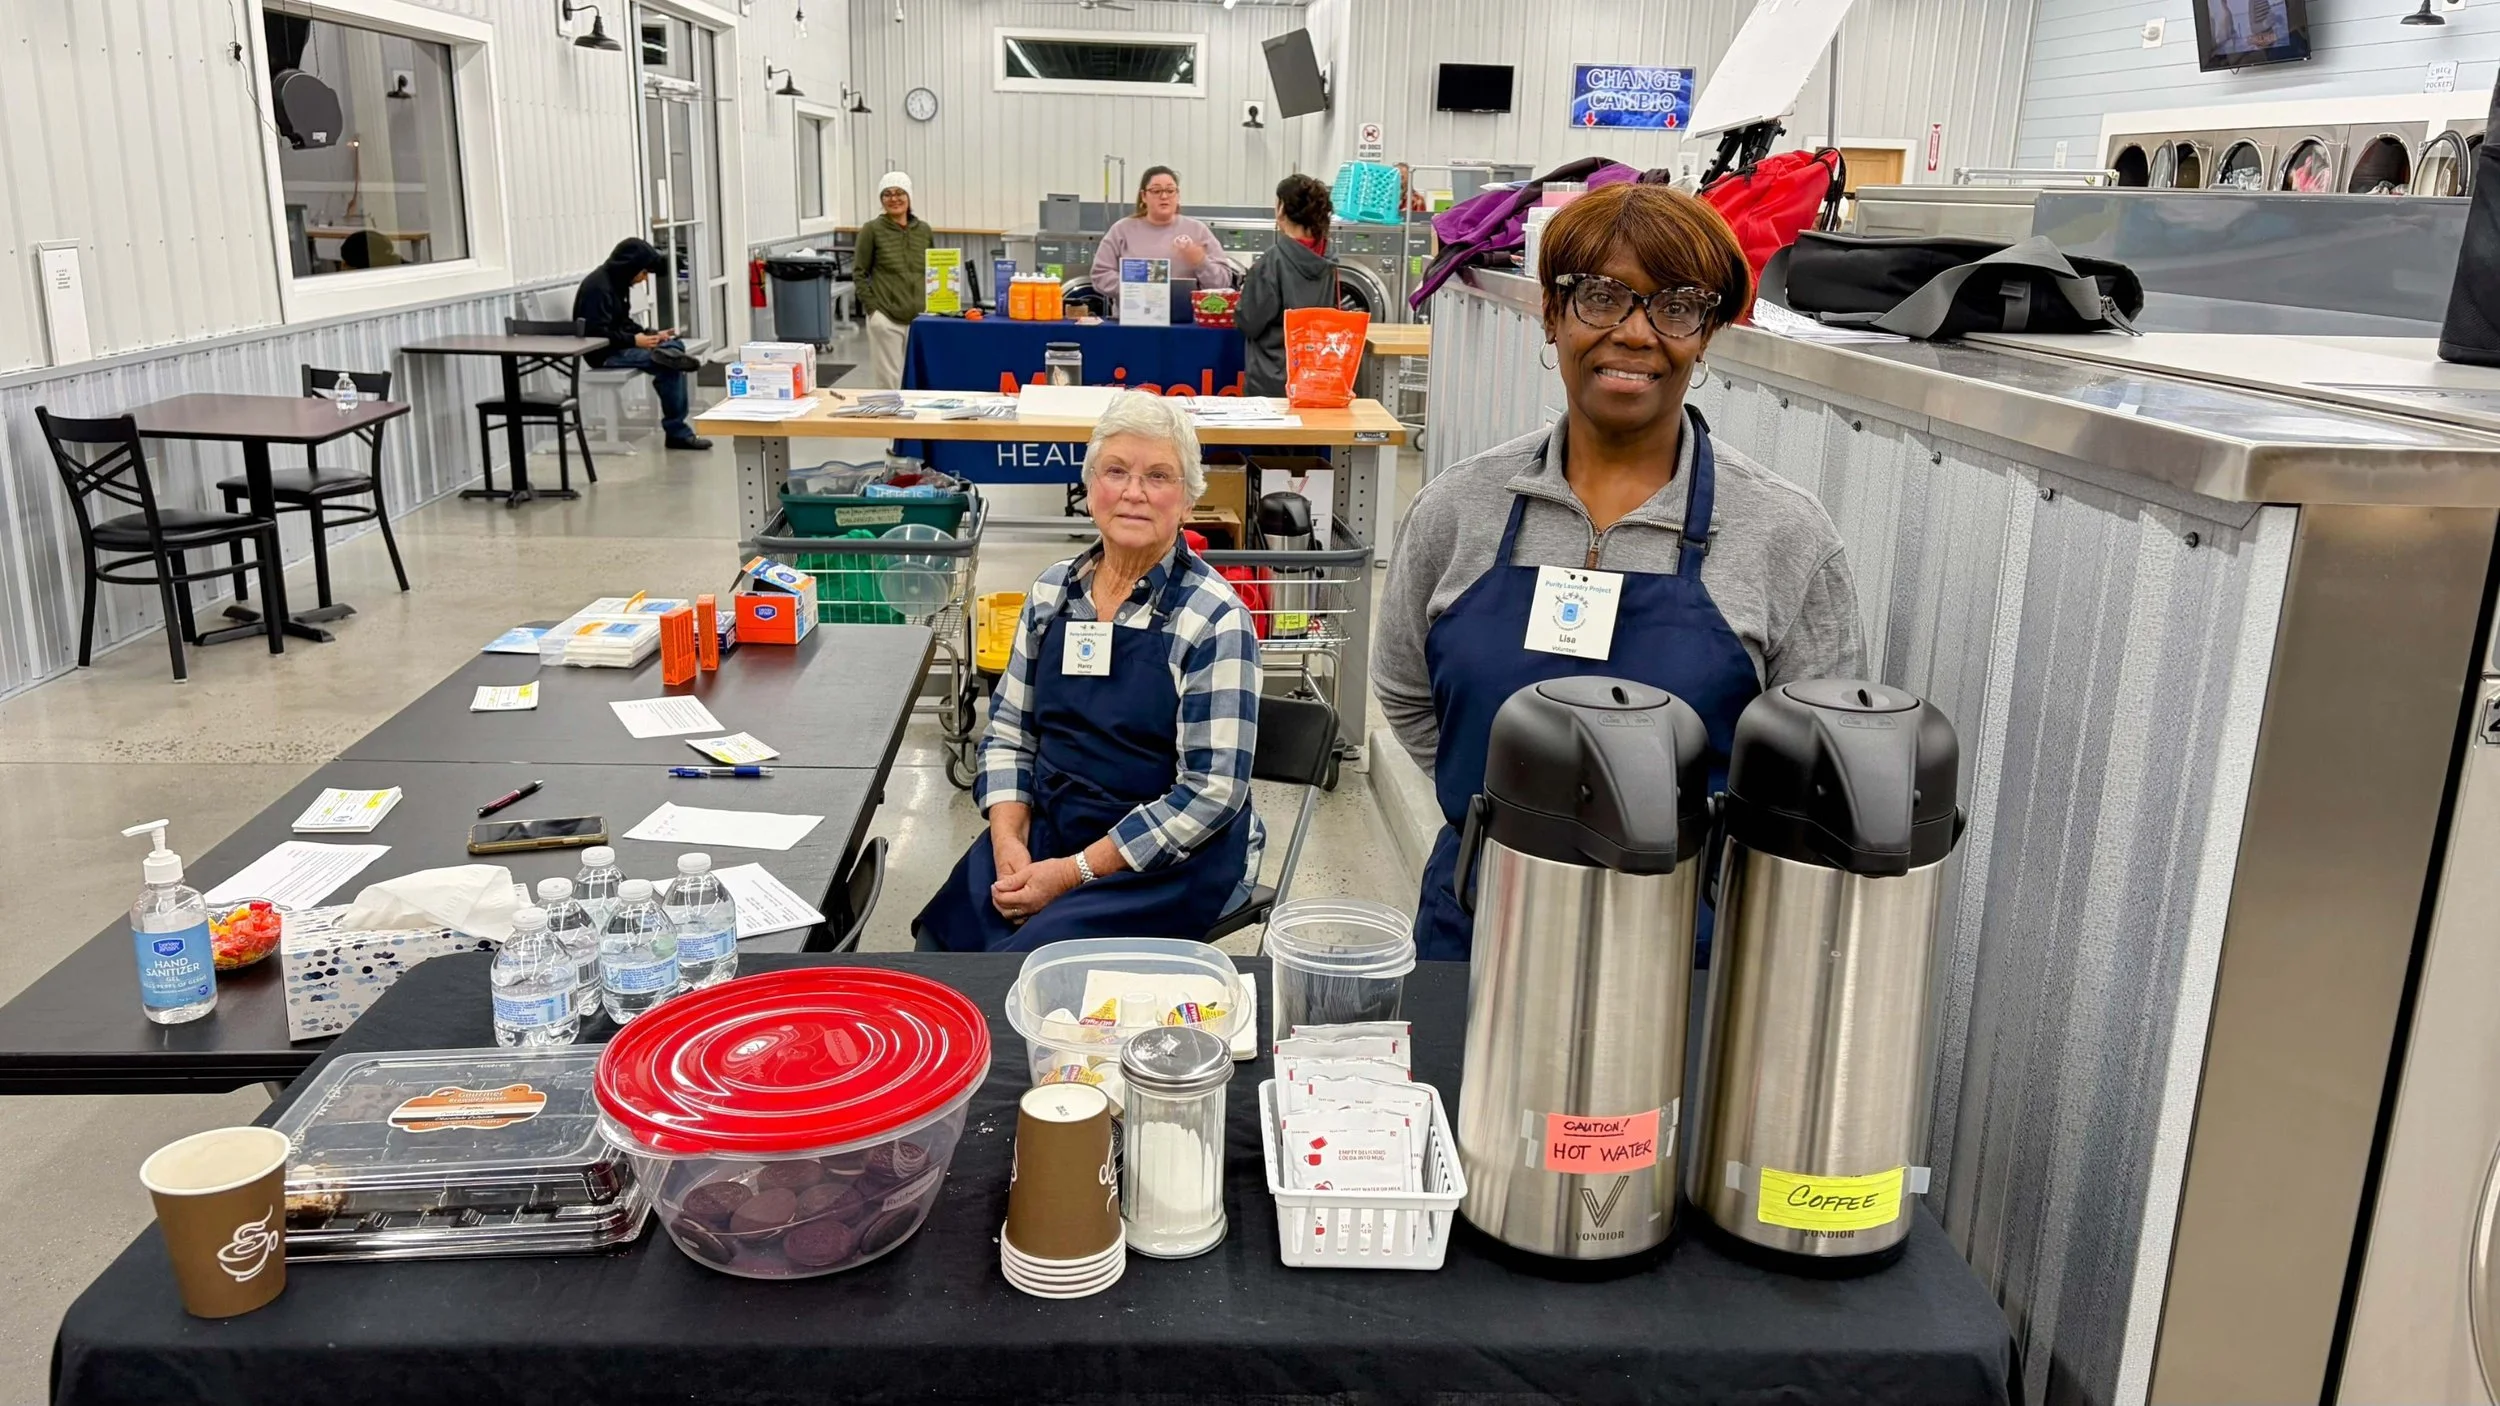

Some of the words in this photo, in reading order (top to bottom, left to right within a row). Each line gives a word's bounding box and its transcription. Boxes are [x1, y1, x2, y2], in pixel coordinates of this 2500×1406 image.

[1586, 69, 1681, 91] CHANGE
[1588, 91, 1677, 112] CAMBIO
[997, 443, 1084, 467] HEAL
[1545, 580, 1563, 589] Purity
[1563, 583, 1589, 592] Laundry
[1589, 585, 1611, 594] Project
[1559, 634, 1576, 644] Lisa
[1552, 645, 1577, 654] Volunteer
[145, 962, 199, 977] SANITIZER
[154, 957, 188, 969] HAND
[1563, 1118, 1630, 1133] CAUTION!
[1554, 1143, 1592, 1160] HOT
[1600, 1139, 1652, 1162] WATER
[1787, 1184, 1879, 1212] COFFEE
[1575, 1230, 1625, 1241] VONDIOR
[1803, 1230, 1855, 1239] VONDIOR
